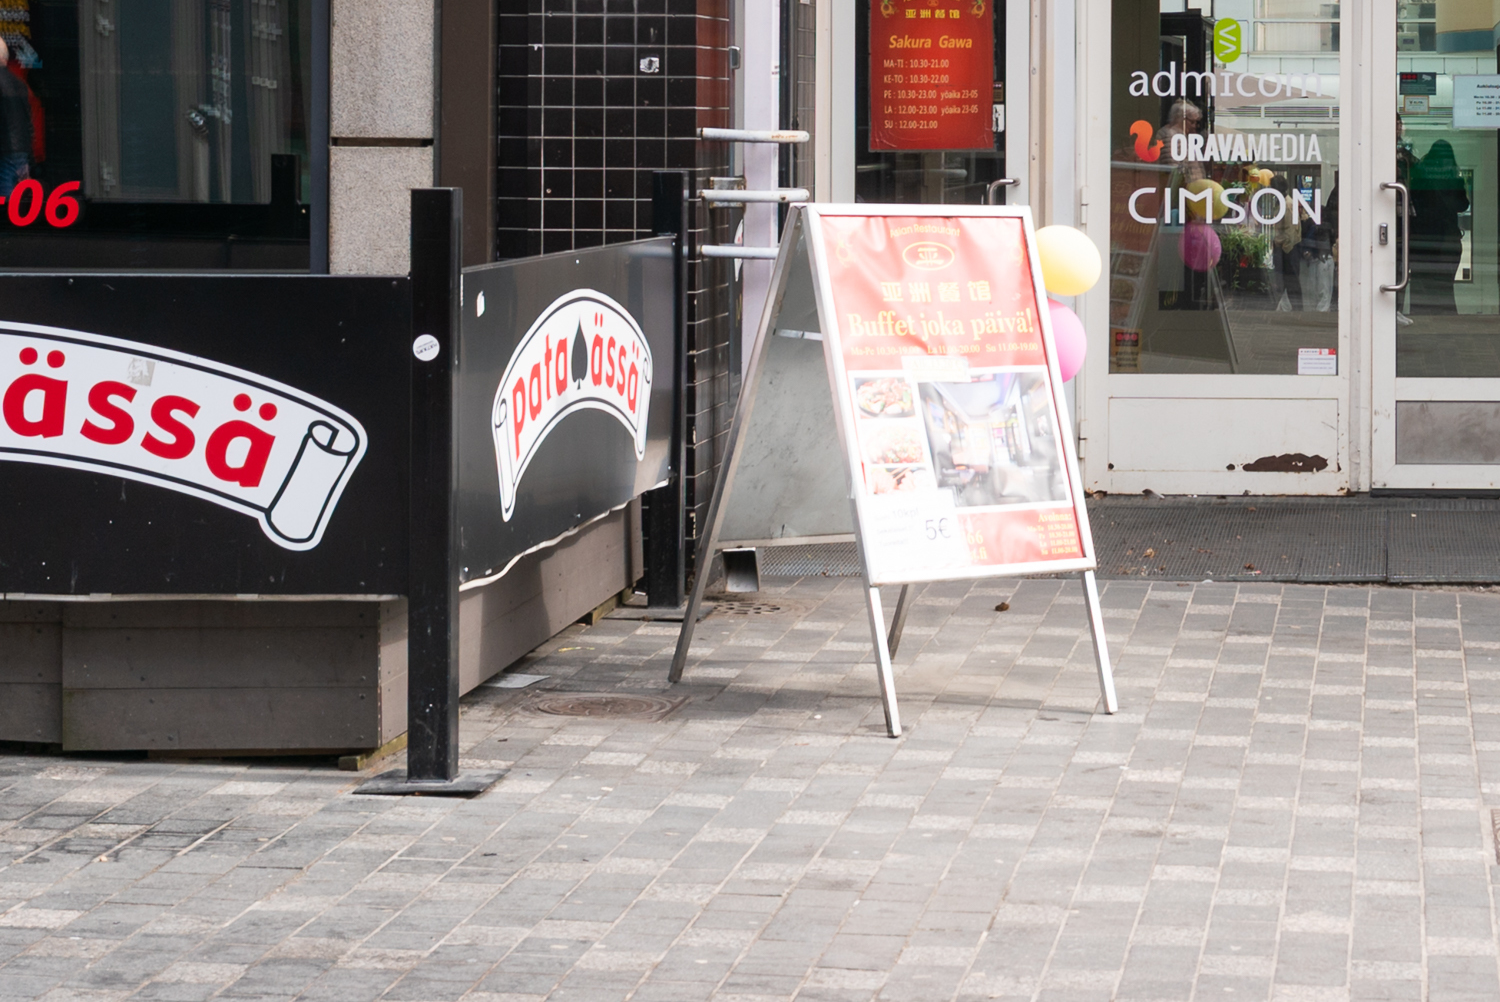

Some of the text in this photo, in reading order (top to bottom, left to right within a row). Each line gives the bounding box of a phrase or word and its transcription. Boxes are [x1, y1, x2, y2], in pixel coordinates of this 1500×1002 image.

[889, 35, 973, 49] Sakura Gawa
[1128, 61, 1321, 97] admicom
[1170, 133, 1322, 162] ORAVAMEDIA
[1128, 187, 1321, 225] CIMSON
[890, 223, 960, 238] Asian Restaurant
[881, 280, 991, 303] 亚洲餐馆
[847, 308, 1034, 341] Buffet joka päivä!
[512, 312, 639, 462] pata ässä
[2, 346, 276, 488] ässä
[925, 517, 951, 541] 5€
[1038, 512, 1072, 523] Avoinna:
